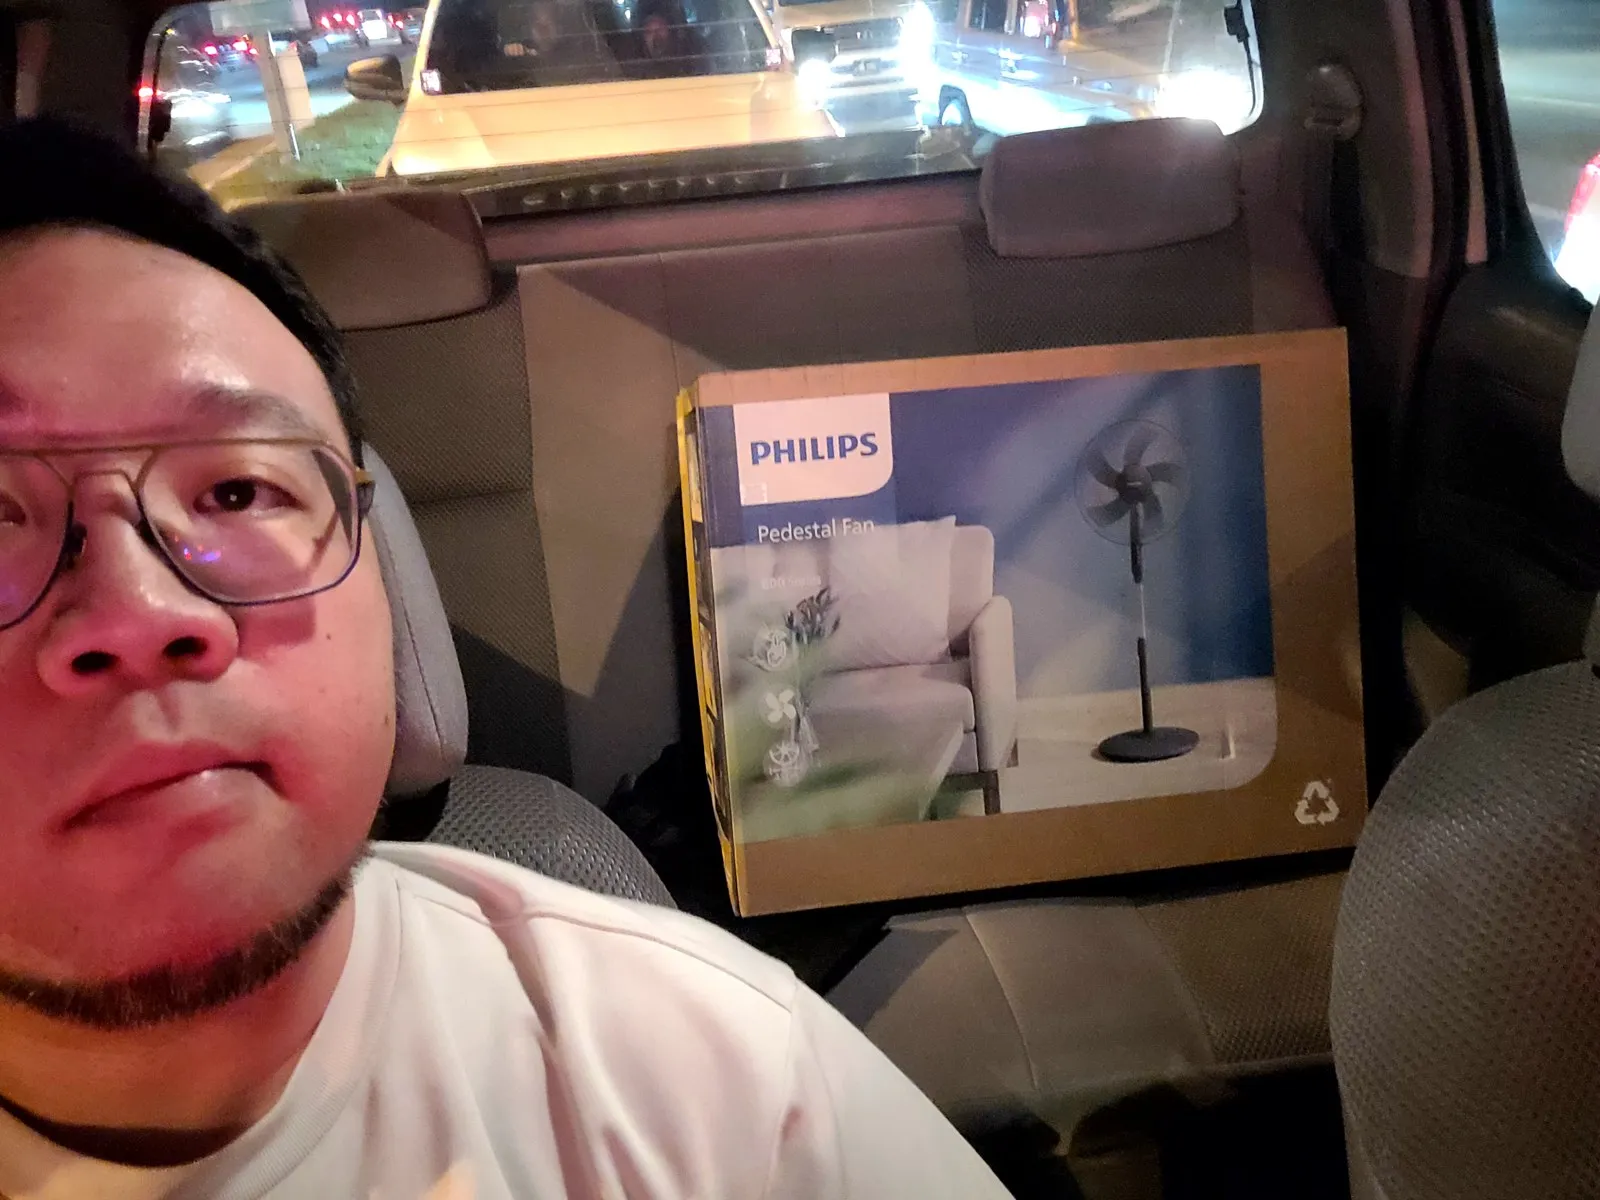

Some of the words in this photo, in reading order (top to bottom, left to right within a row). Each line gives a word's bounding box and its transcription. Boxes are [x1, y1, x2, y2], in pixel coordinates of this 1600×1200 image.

[751, 432, 878, 465] PHILIPS
[758, 518, 836, 543] Pedestal
[843, 517, 875, 535] Fan
